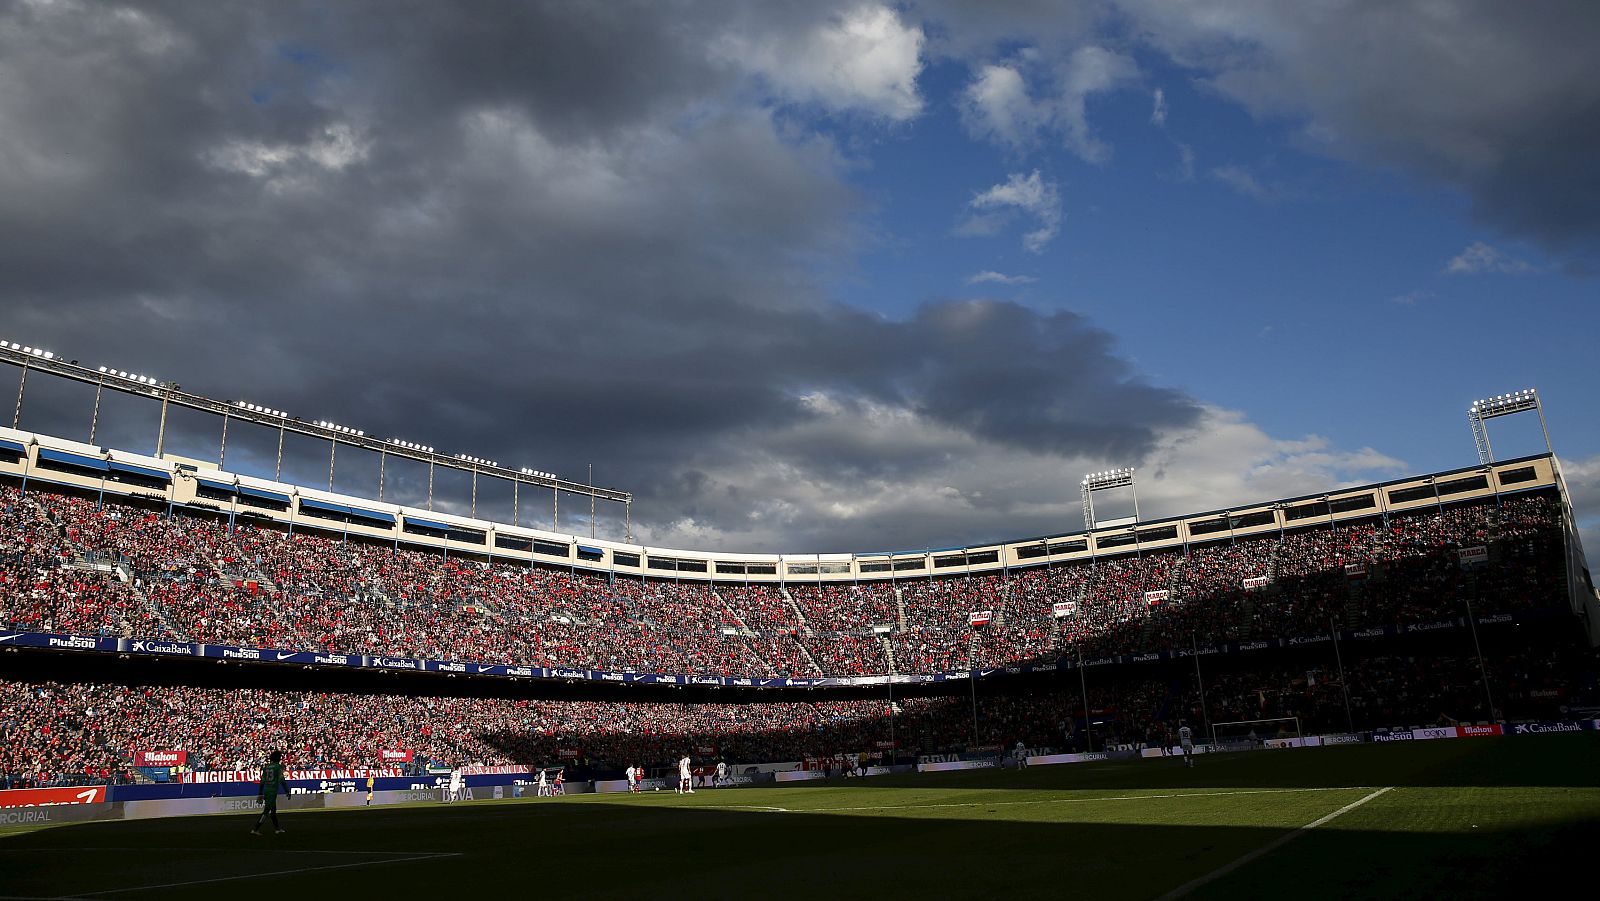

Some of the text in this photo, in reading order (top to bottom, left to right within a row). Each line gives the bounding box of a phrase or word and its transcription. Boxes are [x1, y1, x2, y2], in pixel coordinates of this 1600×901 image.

[1353, 628, 1384, 639] Plus500
[50, 638, 96, 649] Plus500
[1299, 633, 1331, 645] CaixaBank
[146, 641, 192, 655] CaixaBank
[223, 650, 260, 659] Plus500
[315, 656, 348, 665] Plus500
[383, 658, 416, 669] CaixaBank
[438, 664, 466, 672] Plus500
[506, 668, 532, 676] Plus500
[1464, 725, 1493, 734] Mahou
[1530, 721, 1583, 734] CaixaBank
[1374, 734, 1413, 742] Plus500
[144, 752, 178, 762] Mahou
[382, 749, 407, 759] Mahou
[195, 770, 264, 783] MIGUELTUR
[291, 770, 327, 780] SANTA
[330, 769, 351, 779] ANA
[353, 769, 367, 778] DE
